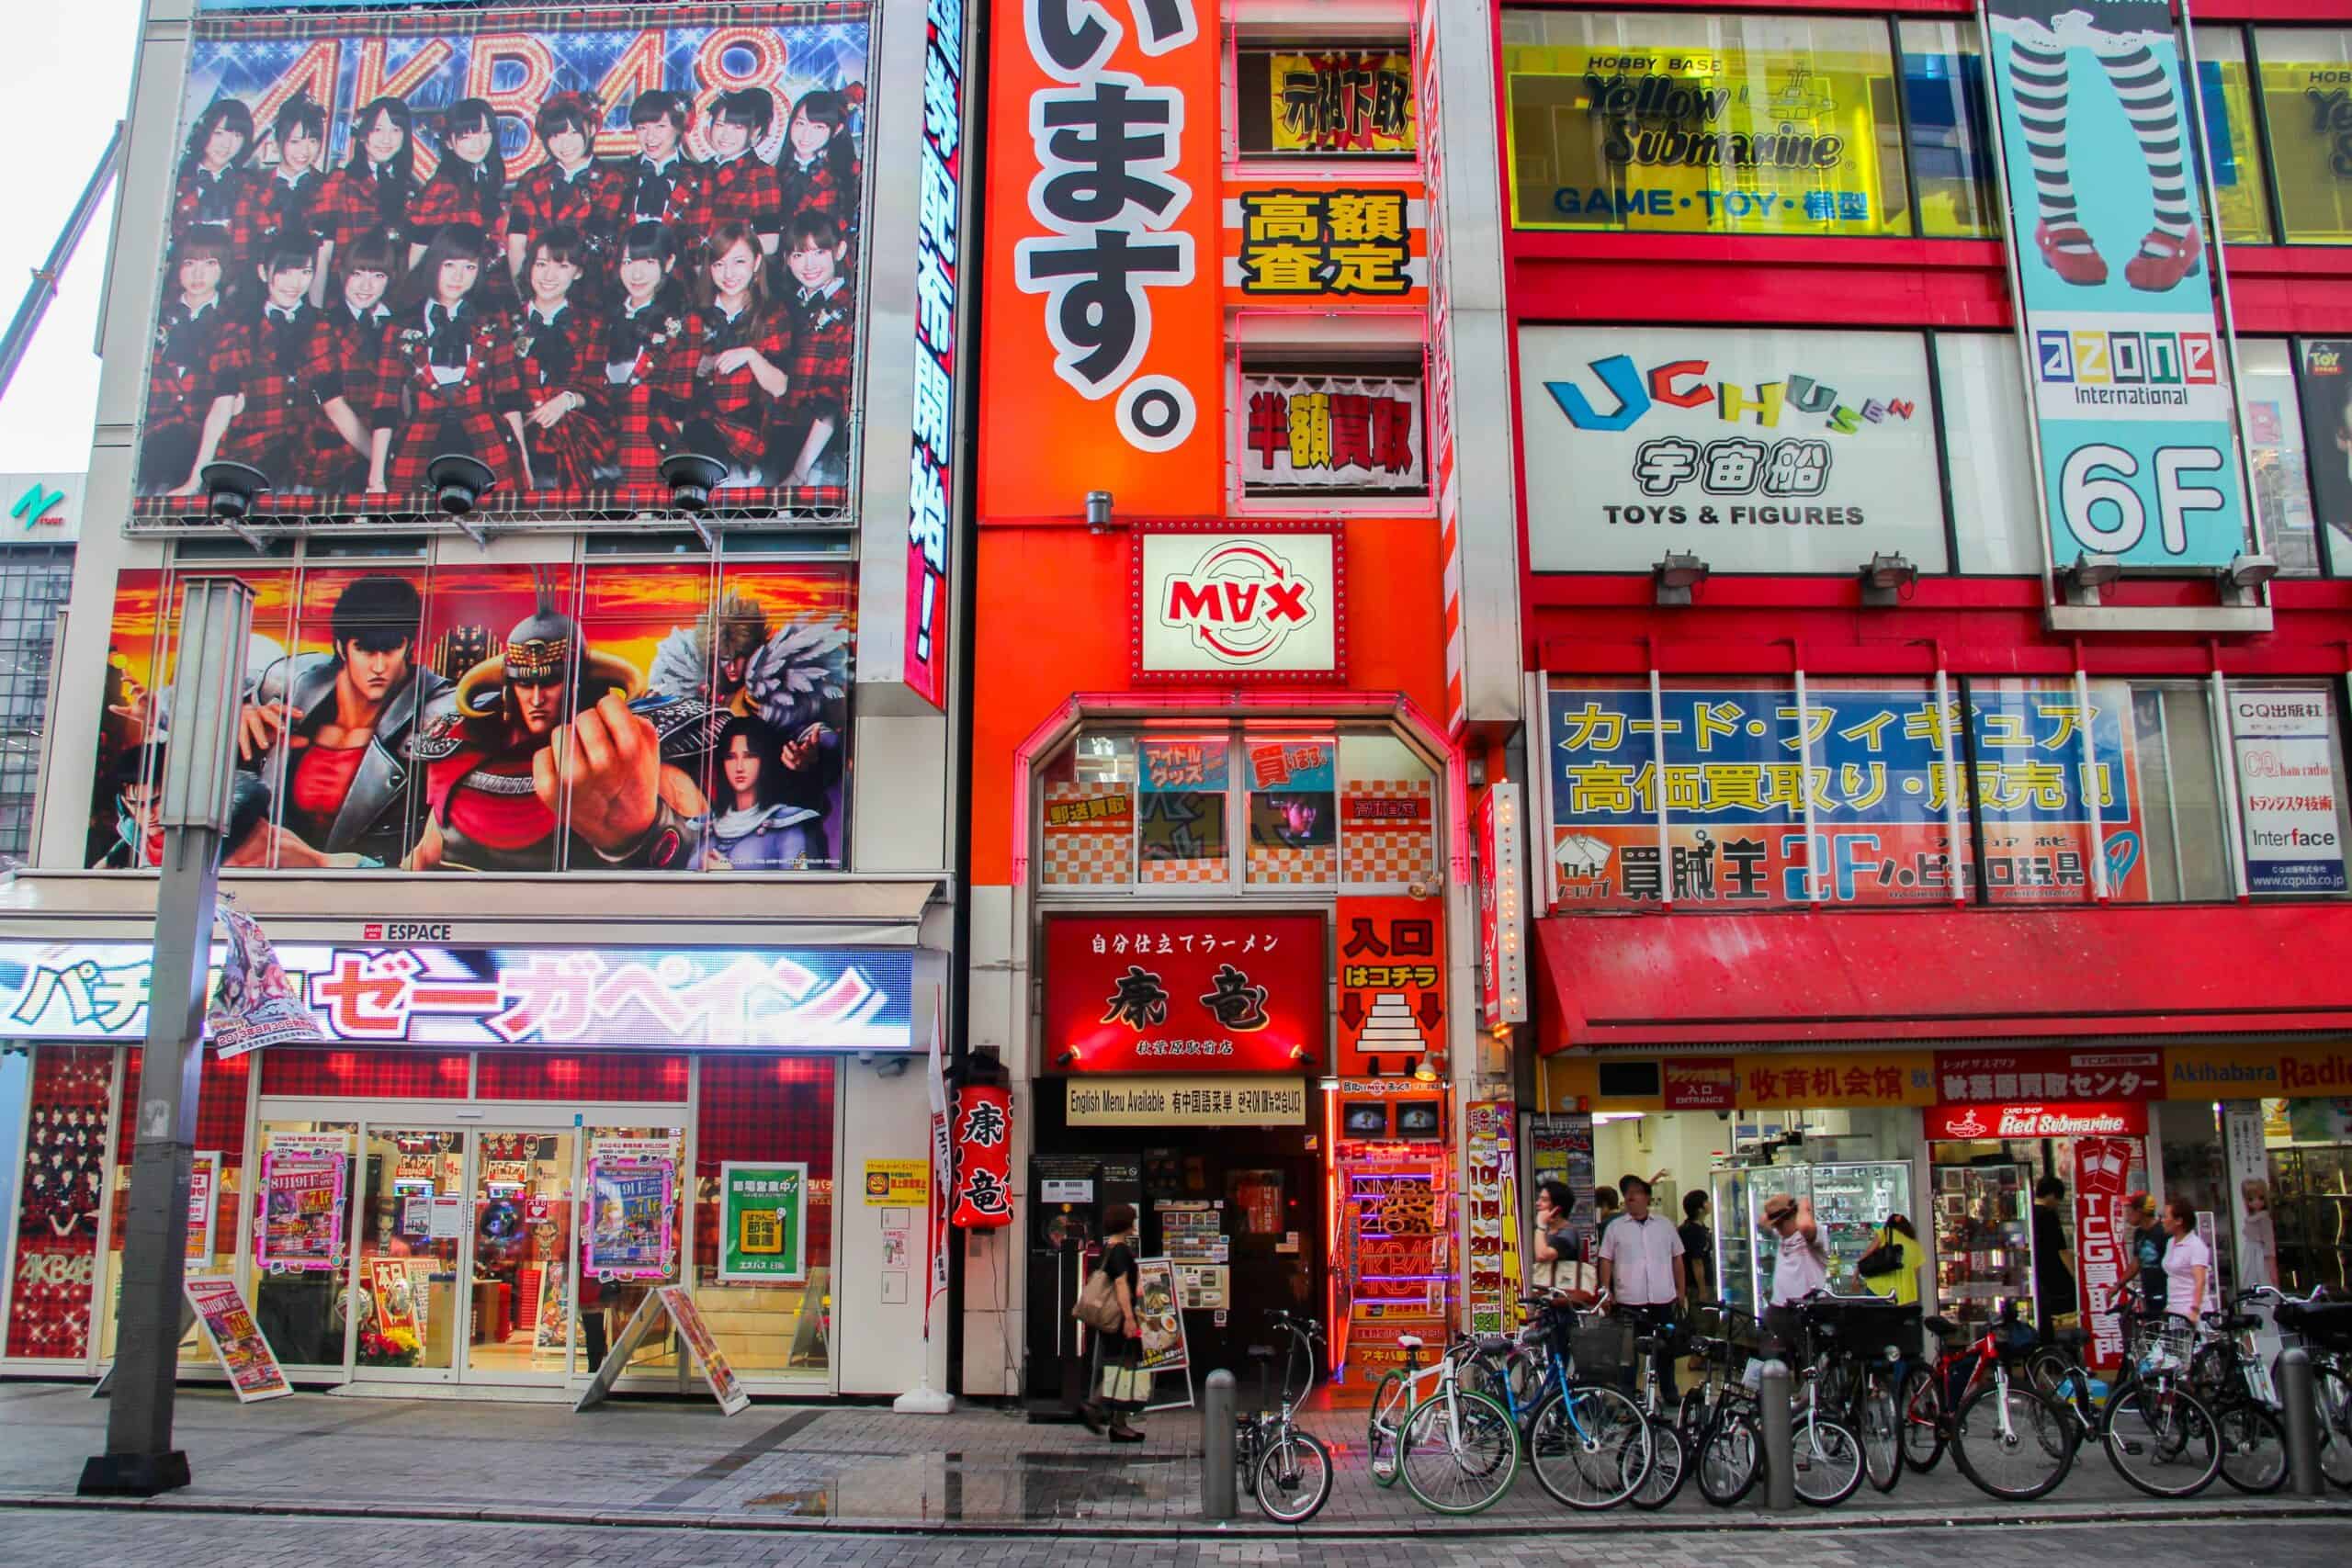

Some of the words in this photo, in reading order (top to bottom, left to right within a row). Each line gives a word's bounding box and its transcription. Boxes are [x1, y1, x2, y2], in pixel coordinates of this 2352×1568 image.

[1588, 56, 1657, 70] HOBBY
[1668, 59, 1721, 73] BASE
[250, 26, 790, 184] AKB48
[1582, 73, 1731, 123] Yellow
[1600, 123, 1844, 169] Submarine
[1240, 189, 1406, 243] 高額
[1242, 243, 1408, 294] 査定
[1543, 354, 1915, 435] UCHUSEN
[2075, 386, 2188, 405] International
[1248, 391, 1413, 476] 半額買取
[1633, 435, 1832, 497] 宇宙船
[2059, 442, 2225, 555] 6F
[1603, 506, 1687, 525] TOYS
[1699, 506, 1719, 525] &
[1731, 506, 1864, 525] FIGURES
[1169, 581, 1306, 623] MAX
[2240, 704, 2322, 717] CQ出版社
[1560, 701, 2101, 752] カード・フィギュア
[2253, 828, 2335, 847] Interface
[2253, 874, 2344, 887] www.cqpub.co.jp
[388, 924, 452, 940] ESPACE
[1091, 932, 1279, 954] 自分仕立てラーメン
[1342, 918, 1433, 957] 入口
[1344, 965, 1438, 988] はコチラ
[2173, 1061, 2277, 1082] Akihabara
[1070, 1090, 1100, 1114] English
[1102, 1090, 1125, 1112] Menu
[1127, 1089, 1165, 1112] Available
[1997, 1114, 2035, 1134] Red
[2038, 1112, 2123, 1134] Submarine
[17, 1254, 95, 1285] AKB48
